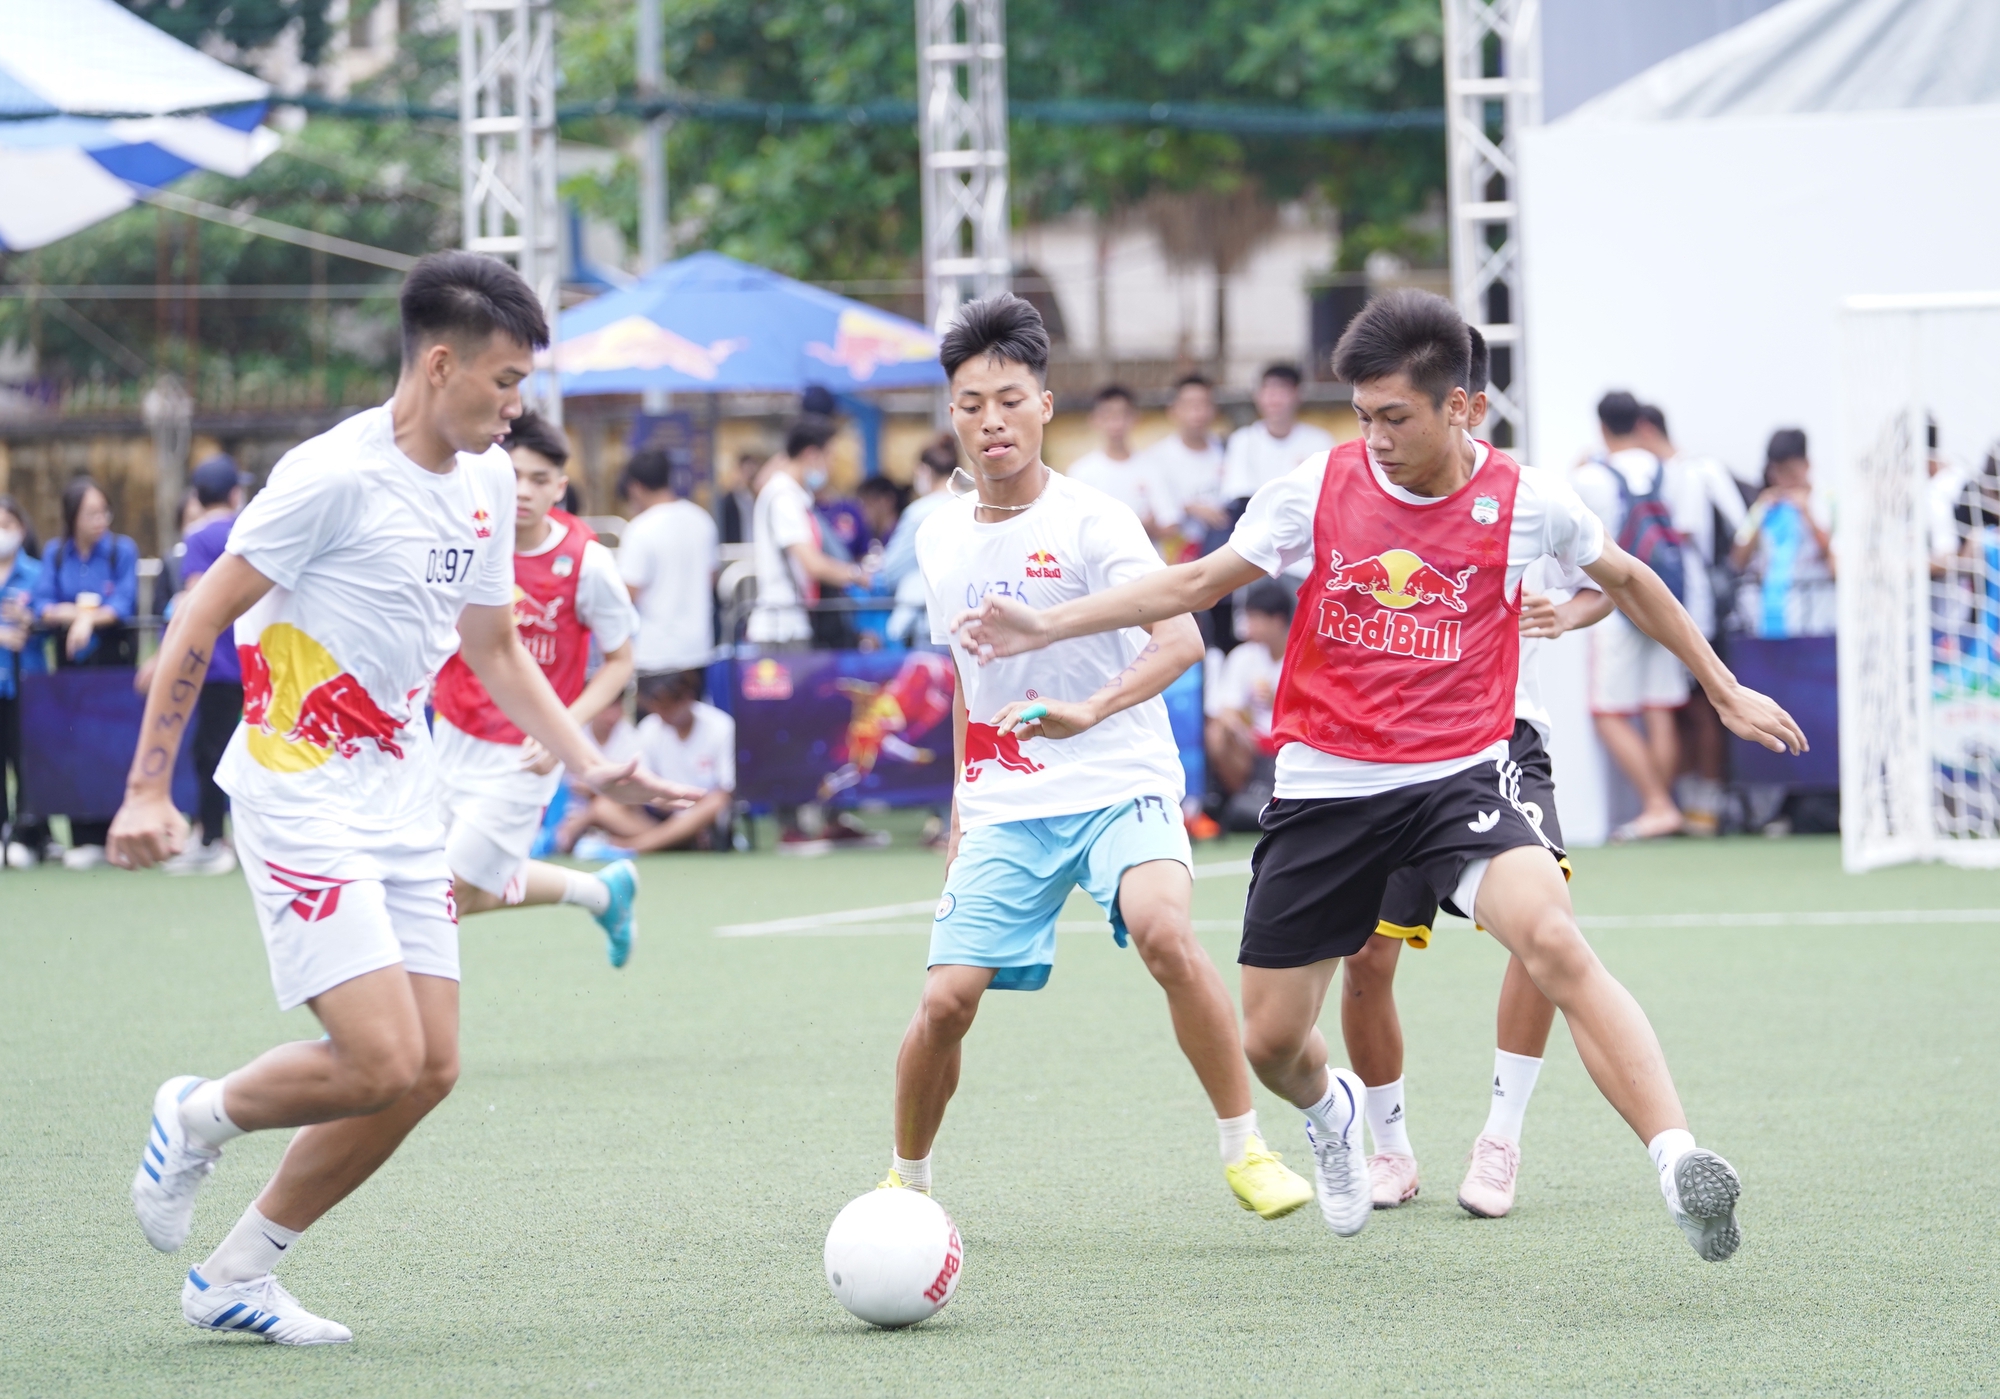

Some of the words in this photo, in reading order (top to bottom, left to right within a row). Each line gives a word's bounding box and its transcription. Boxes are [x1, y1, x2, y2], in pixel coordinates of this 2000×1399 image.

[1026, 567, 1043, 578] Red
[1043, 567, 1062, 579] Bull
[1318, 598, 1391, 651] Red
[1387, 612, 1462, 662] Bull
[142, 646, 207, 777] 0397
[923, 1252, 960, 1305] Bull
